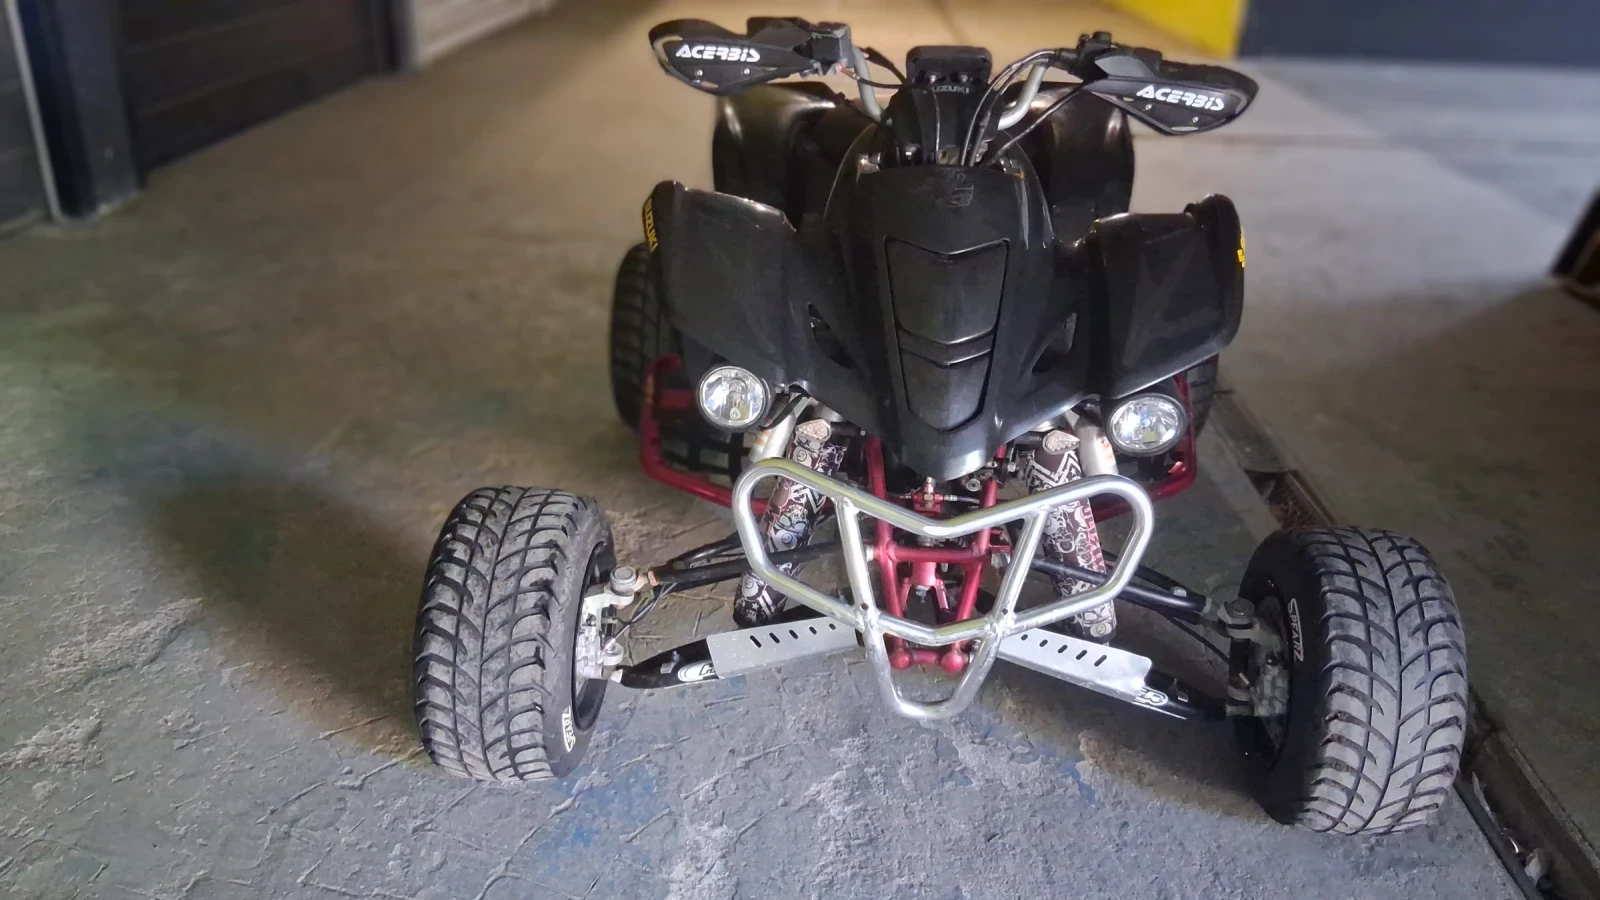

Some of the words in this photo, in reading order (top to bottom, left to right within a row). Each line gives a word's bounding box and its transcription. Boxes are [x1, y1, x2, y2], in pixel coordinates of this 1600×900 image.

[675, 44, 761, 63] ACERBIS
[1136, 85, 1225, 111] ACERBIS
[1287, 597, 1305, 662] SPEARZ
